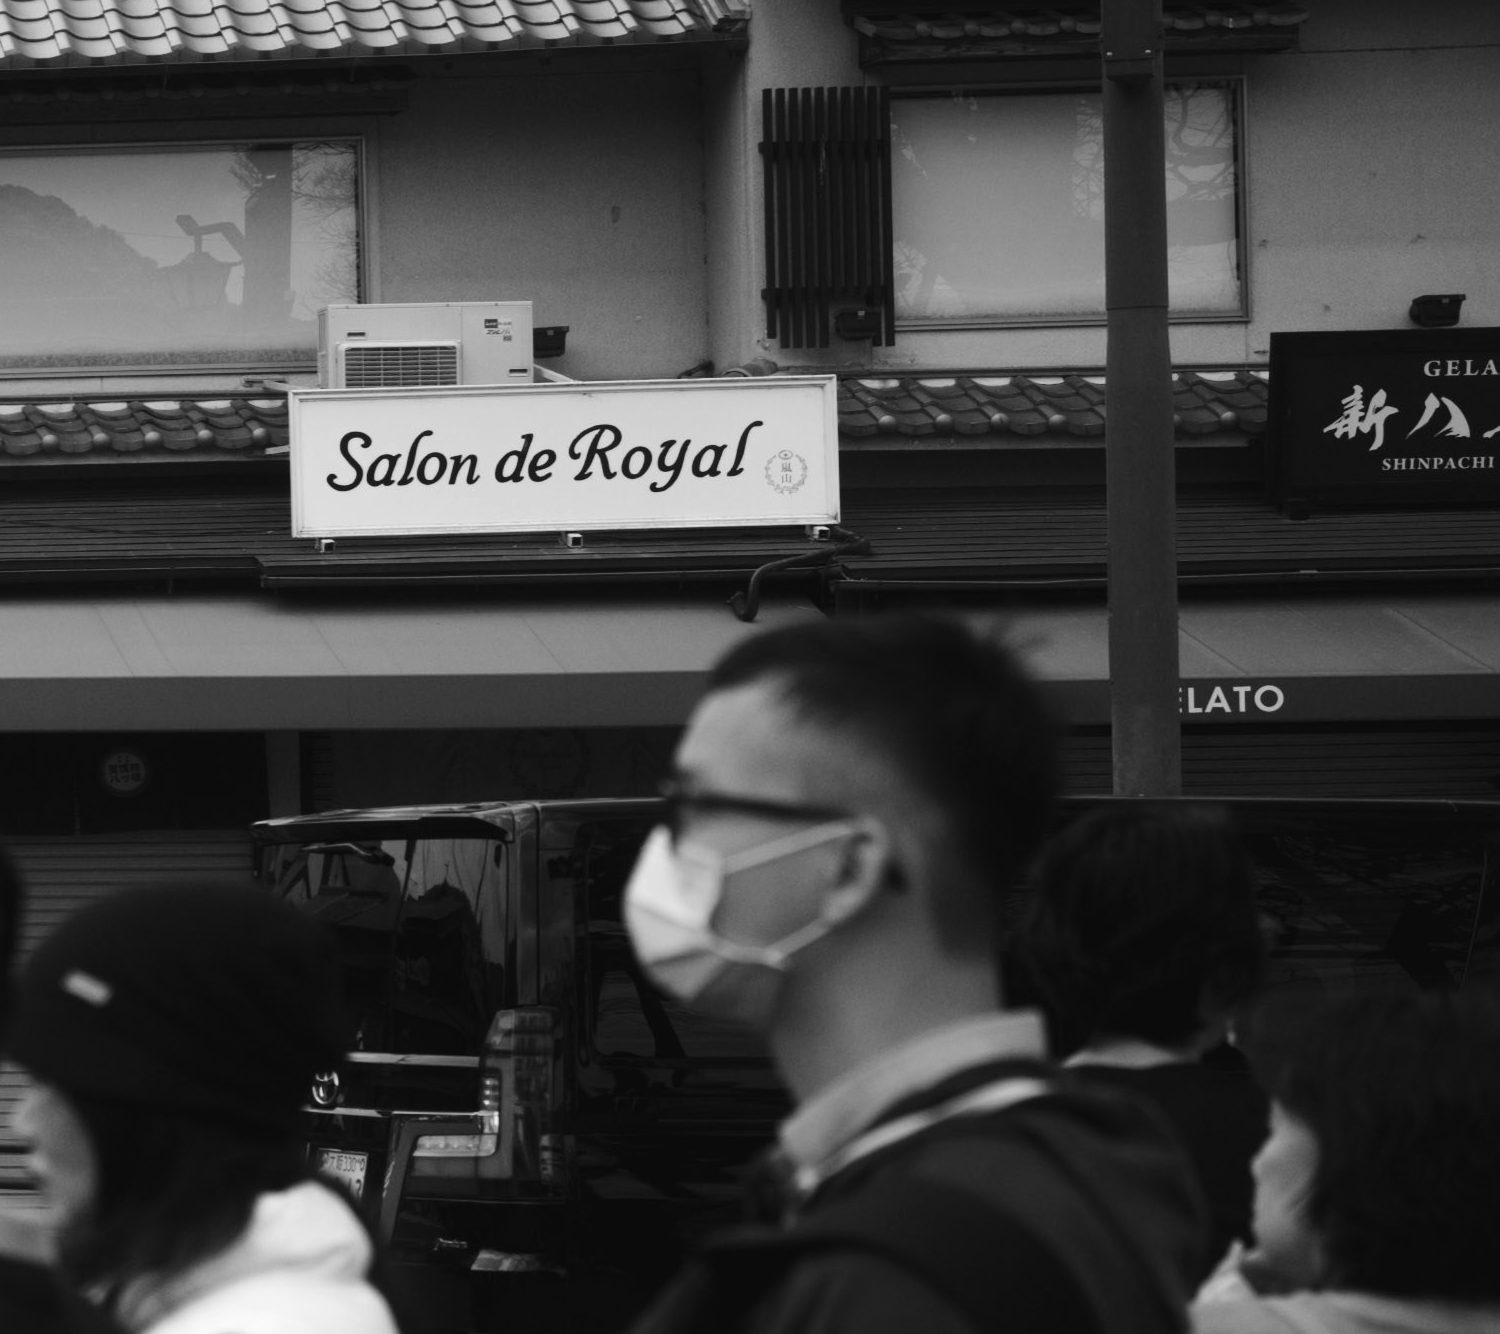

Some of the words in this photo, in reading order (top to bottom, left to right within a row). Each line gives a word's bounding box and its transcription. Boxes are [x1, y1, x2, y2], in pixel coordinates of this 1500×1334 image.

[1423, 359, 1500, 378] GELA
[1323, 384, 1500, 451] 新八
[326, 430, 480, 492] Salon
[494, 433, 557, 483] de
[568, 420, 763, 493] Royal
[1381, 456, 1495, 471] SHINPACHI
